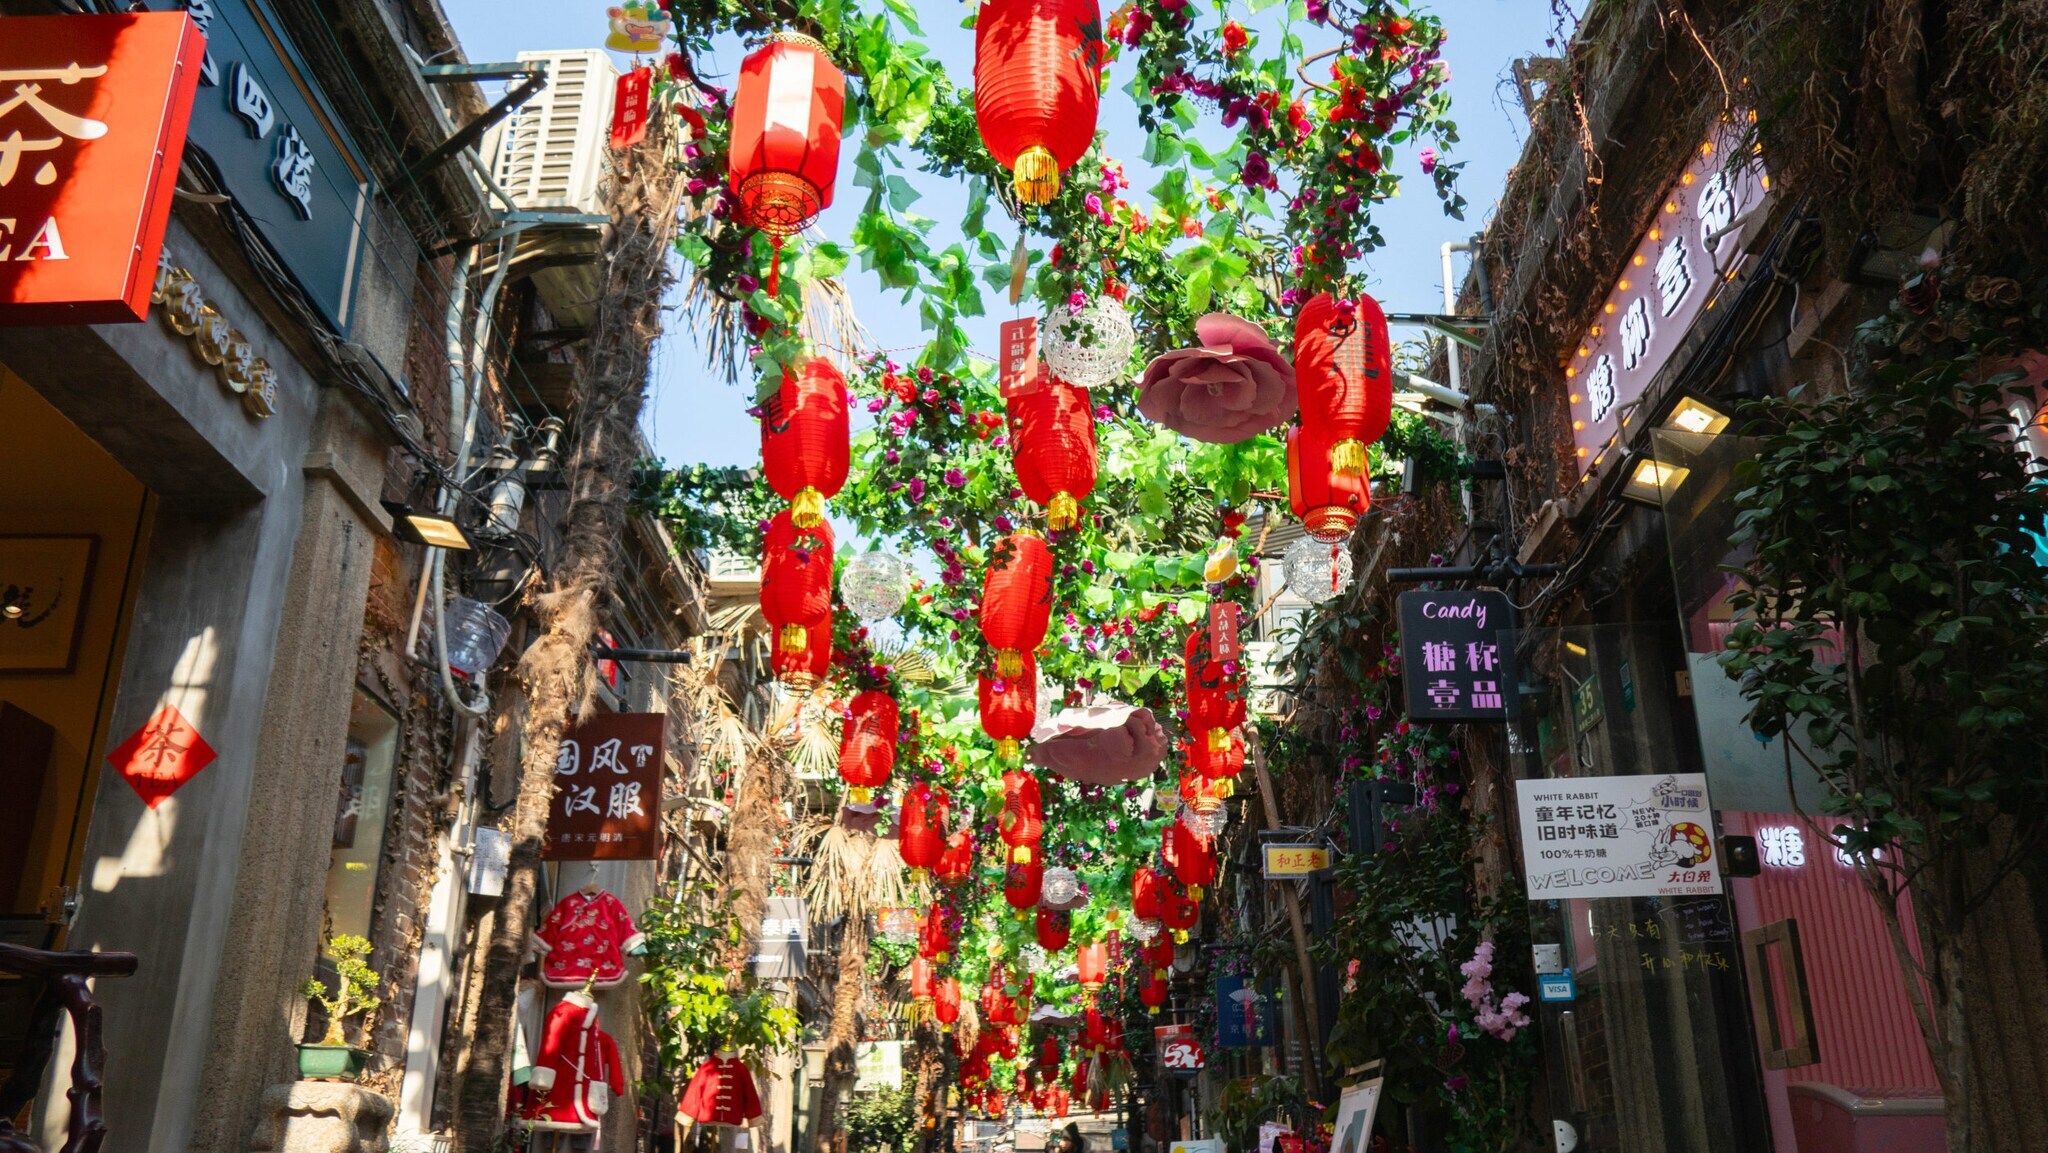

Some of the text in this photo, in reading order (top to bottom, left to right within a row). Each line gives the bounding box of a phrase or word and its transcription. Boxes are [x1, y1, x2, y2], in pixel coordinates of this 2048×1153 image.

[1422, 598, 1487, 629] Candy
[1427, 679, 1502, 710] 壹品
[1579, 684, 1594, 715] 35
[142, 723, 189, 768] 茶
[555, 738, 628, 775] 国风
[132, 772, 180, 789] TEA
[565, 782, 644, 819] 汉服
[1533, 792, 1599, 802] WHITE RABBIT
[1661, 796, 1699, 808] 小时候
[1535, 804, 1617, 822] 童年记忆
[1632, 807, 1656, 816] NEW
[561, 832, 624, 842] 唐宋元明清
[1538, 823, 1619, 841] 旧时味道
[1540, 848, 1607, 859] 100%牛奶糖
[1529, 861, 1656, 890] WELCOME
[1667, 870, 1711, 883] 大白兔
[1658, 886, 1715, 895] WHITE RABBIT
[1547, 985, 1568, 993] VISA
